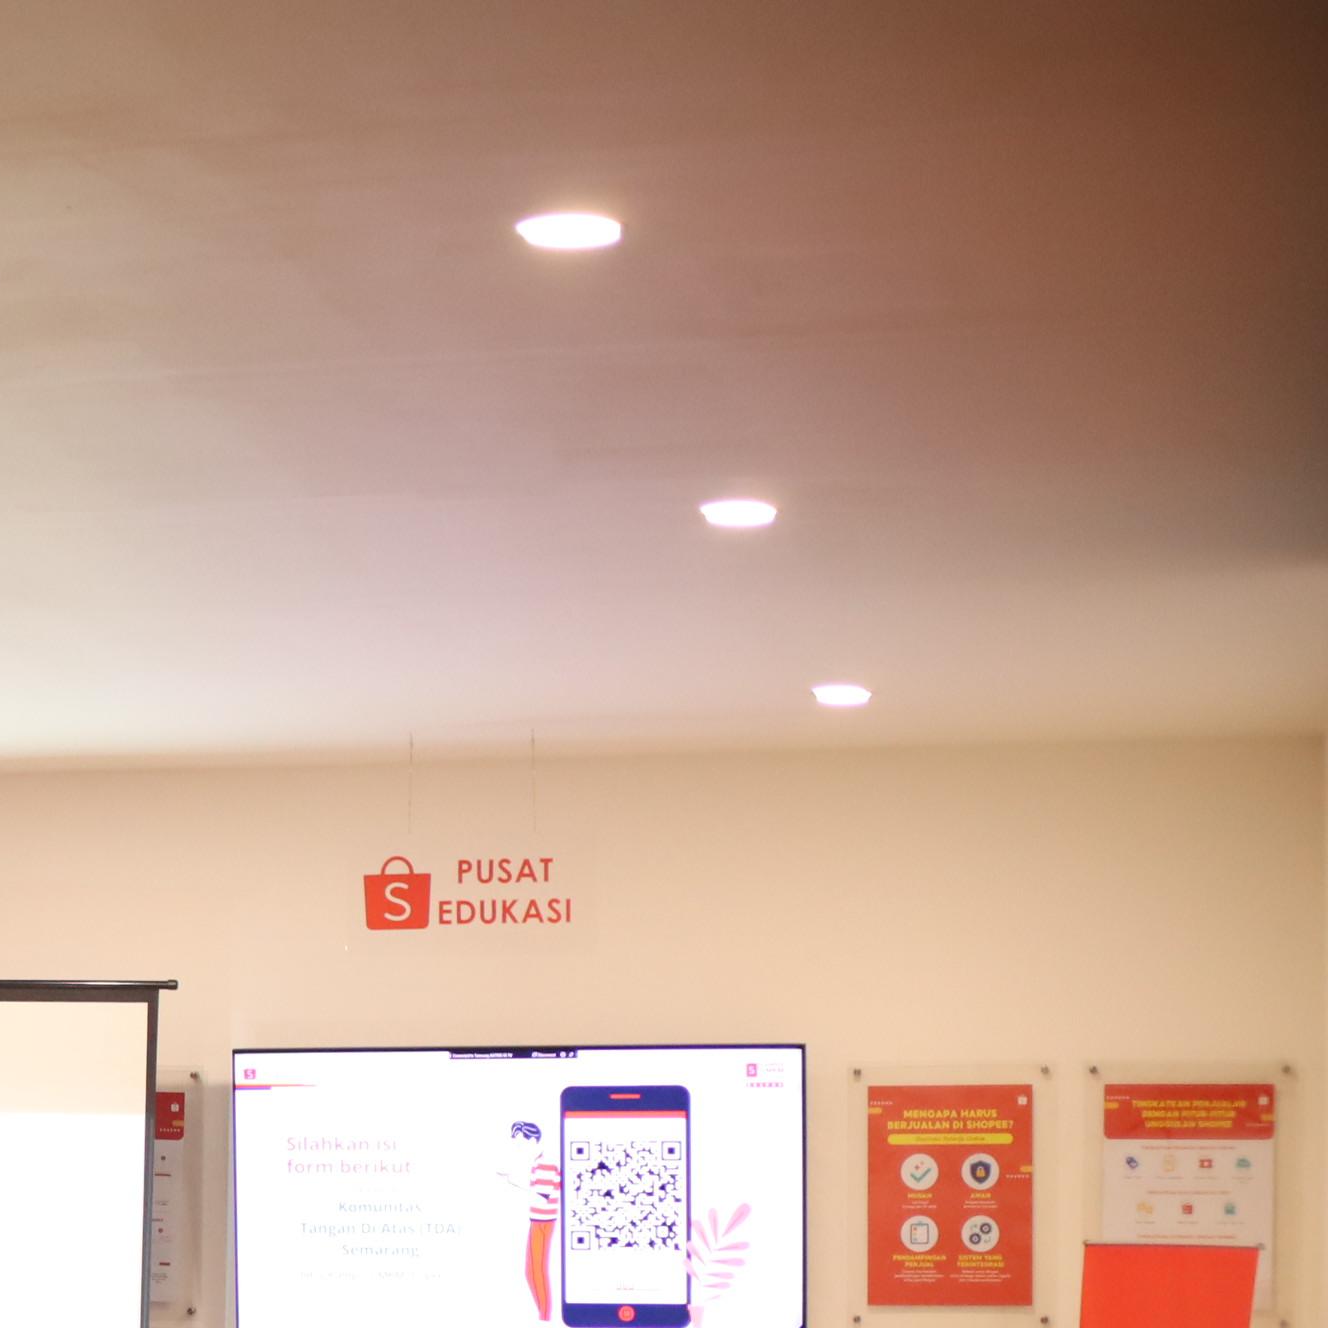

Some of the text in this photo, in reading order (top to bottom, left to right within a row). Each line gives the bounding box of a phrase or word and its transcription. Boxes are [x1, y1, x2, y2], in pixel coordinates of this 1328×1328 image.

[457, 858, 554, 884] PUSAT
[438, 898, 572, 925] EDUKASI
[903, 1108, 997, 1118] MENGAPA HARUS
[887, 1119, 1014, 1130] BERJUALAN DI SHOPEE?
[286, 1136, 369, 1152] Silahkan
[287, 1158, 411, 1174] form berikut
